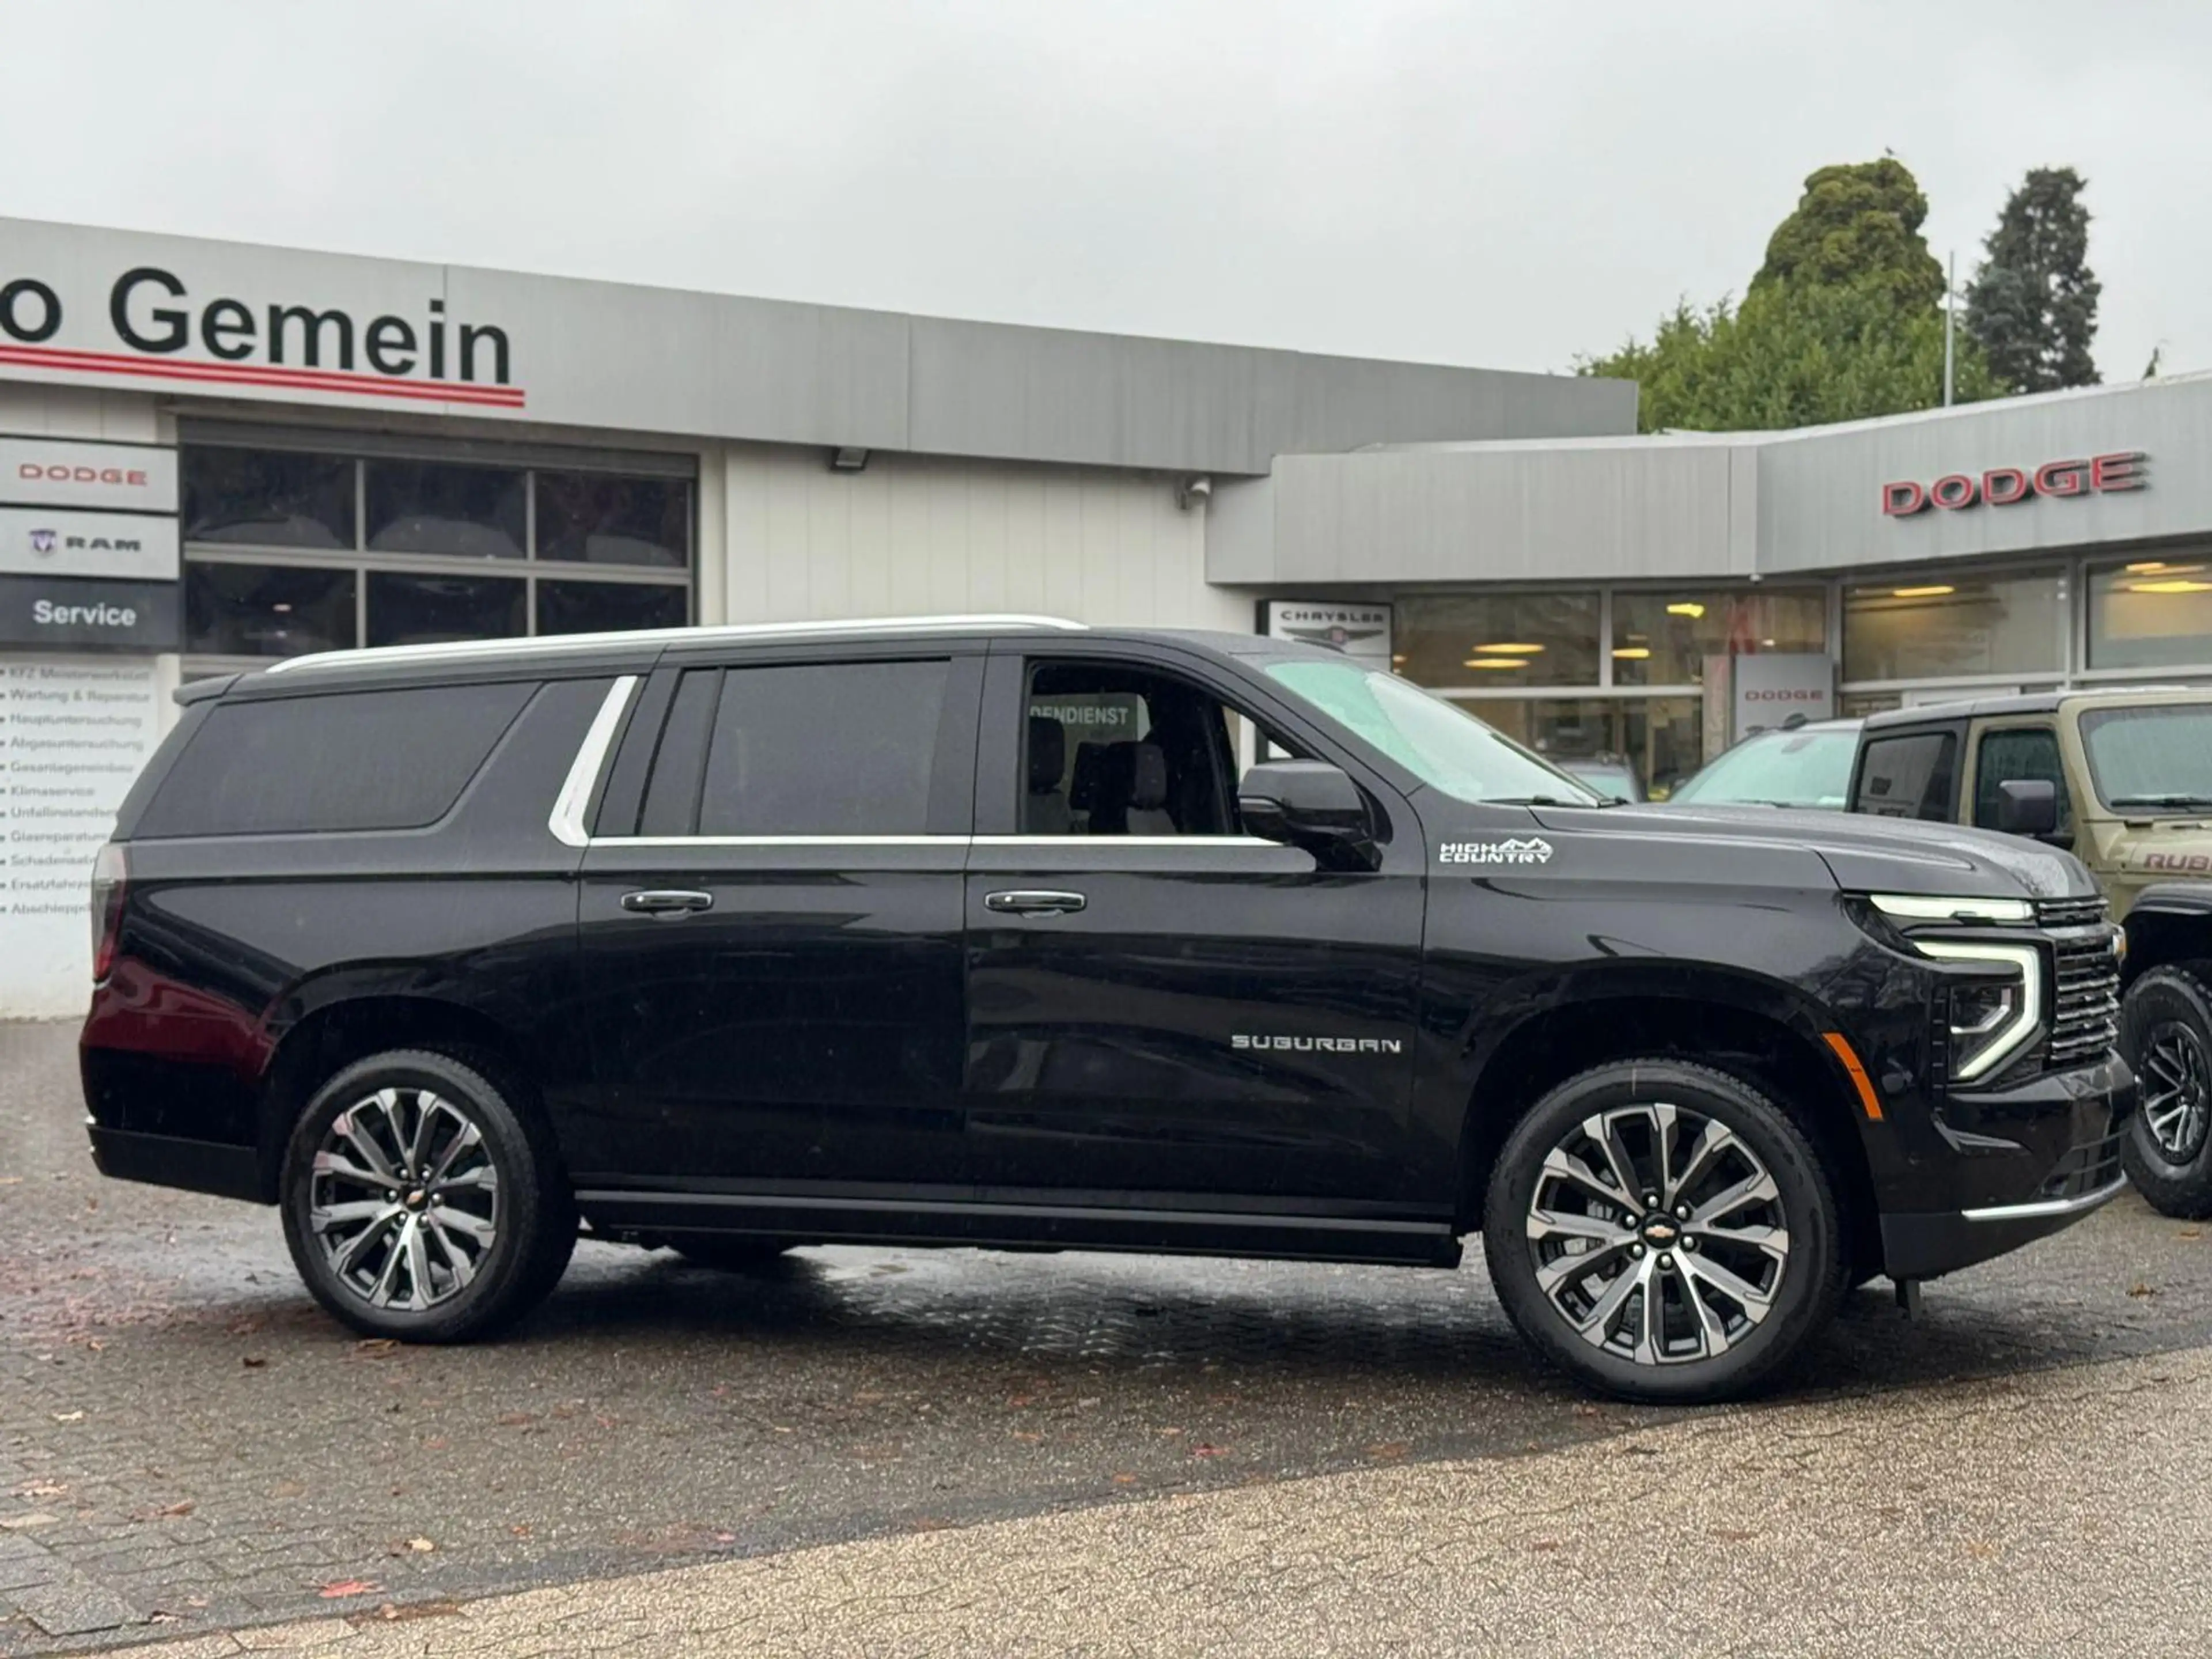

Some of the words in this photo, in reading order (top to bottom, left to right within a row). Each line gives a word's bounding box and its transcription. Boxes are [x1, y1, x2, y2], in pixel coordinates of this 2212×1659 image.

[109, 266, 509, 384] Gemein
[19, 464, 147, 487] DODGE
[1883, 451, 2151, 516] DODGE
[66, 536, 142, 552] RAM
[33, 599, 137, 627] Service
[1279, 611, 1384, 623] CHRYSLER
[1745, 690, 1824, 701] DODGE
[1440, 843, 1498, 853] HIGH
[1439, 853, 1550, 863] COUNTRY
[2143, 853, 2212, 870] RUB
[1231, 1035, 1402, 1053] SUBURBAN
